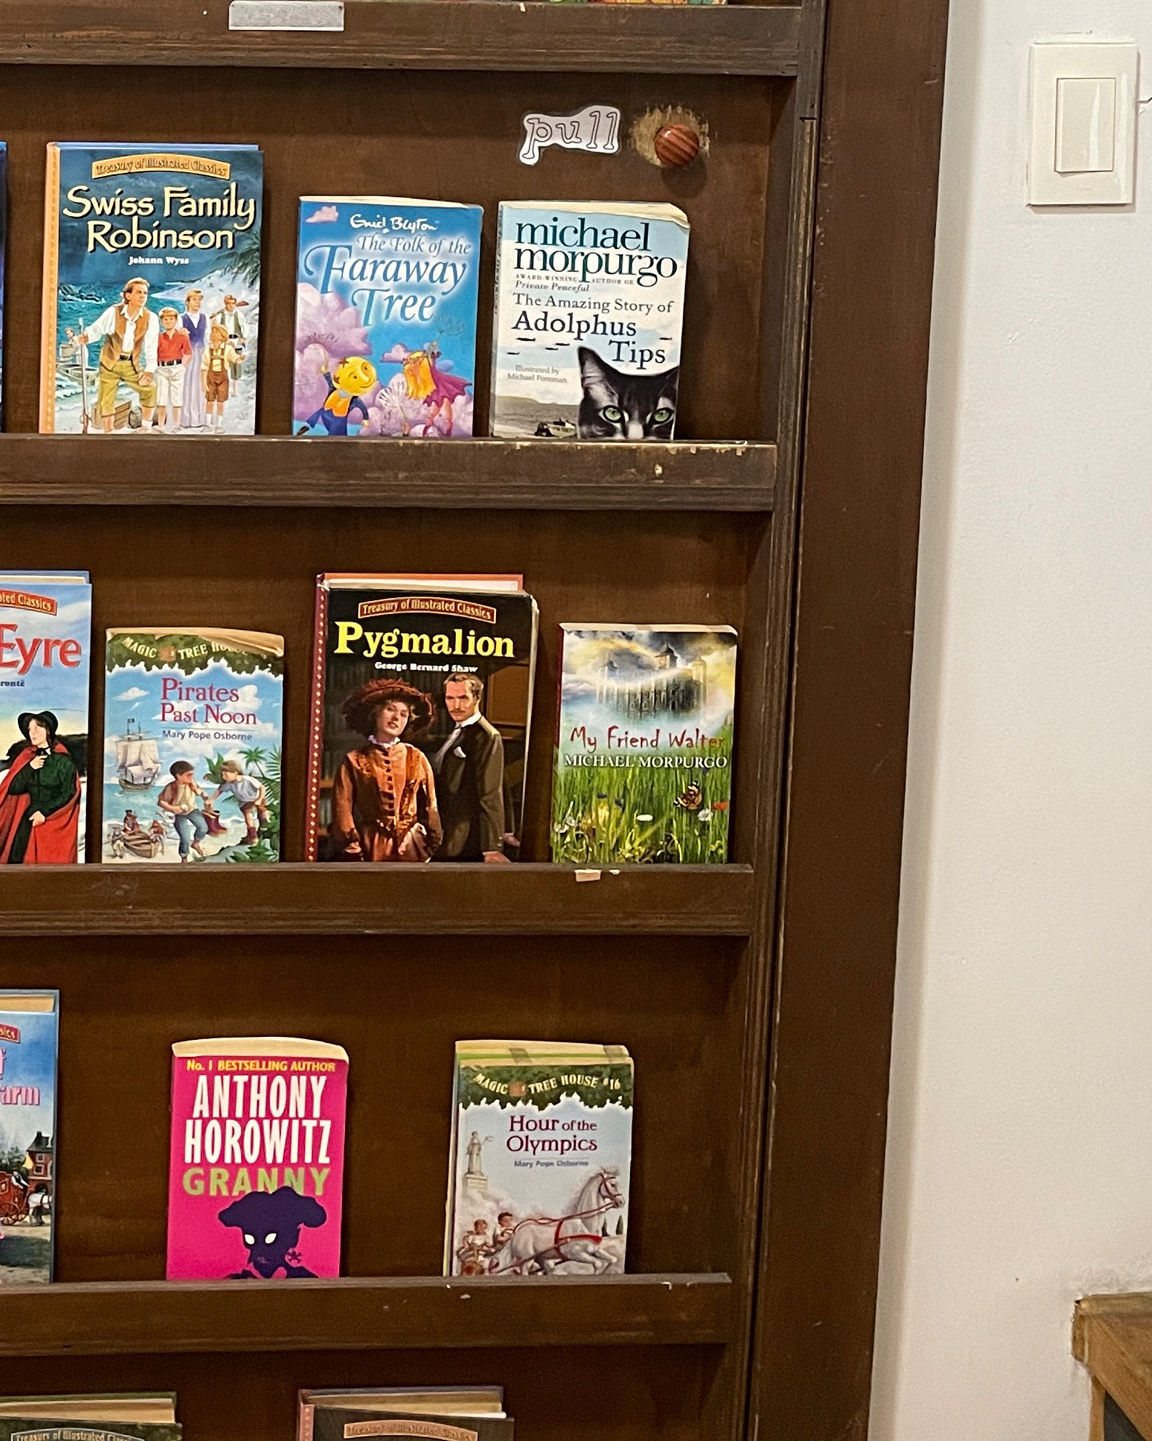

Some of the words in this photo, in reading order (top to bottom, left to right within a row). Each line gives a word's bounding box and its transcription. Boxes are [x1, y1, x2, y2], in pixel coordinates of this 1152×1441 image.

[521, 110, 619, 159] pull
[62, 186, 154, 218] Swiss
[163, 182, 256, 231] Family
[87, 216, 235, 252] Robinson
[515, 217, 652, 252] michael
[303, 245, 467, 295] Faraway
[513, 247, 678, 287] morpurgo
[515, 280, 548, 290] Private
[551, 283, 590, 293] Peaceful
[351, 288, 436, 327] Tree
[512, 292, 541, 306] The
[545, 295, 610, 313] Amazing
[614, 299, 653, 315] Story
[656, 301, 675, 313] of
[511, 310, 637, 341] Adolphus
[607, 339, 666, 369] Tips
[552, 367, 559, 376] by
[18, 594, 52, 611] Classics
[122, 636, 157, 659] MAGIC
[178, 643, 209, 660] TREE
[333, 620, 516, 658] Pygmalion
[160, 677, 240, 703] Pirates
[160, 702, 199, 723] Past
[204, 704, 258, 725] Noon
[570, 725, 598, 754] My
[607, 725, 661, 749] Friend
[668, 729, 726, 749] Walter
[564, 754, 635, 768] MICHAEL
[639, 755, 728, 769] MORPURGO
[192, 1075, 327, 1118] ANTHONY
[509, 1115, 560, 1133] Hour
[562, 1120, 576, 1132] of
[577, 1120, 597, 1131] the
[184, 1119, 332, 1164] HOROWITZ
[506, 1135, 598, 1156] Olympics
[182, 1167, 331, 1197] GRANNY
